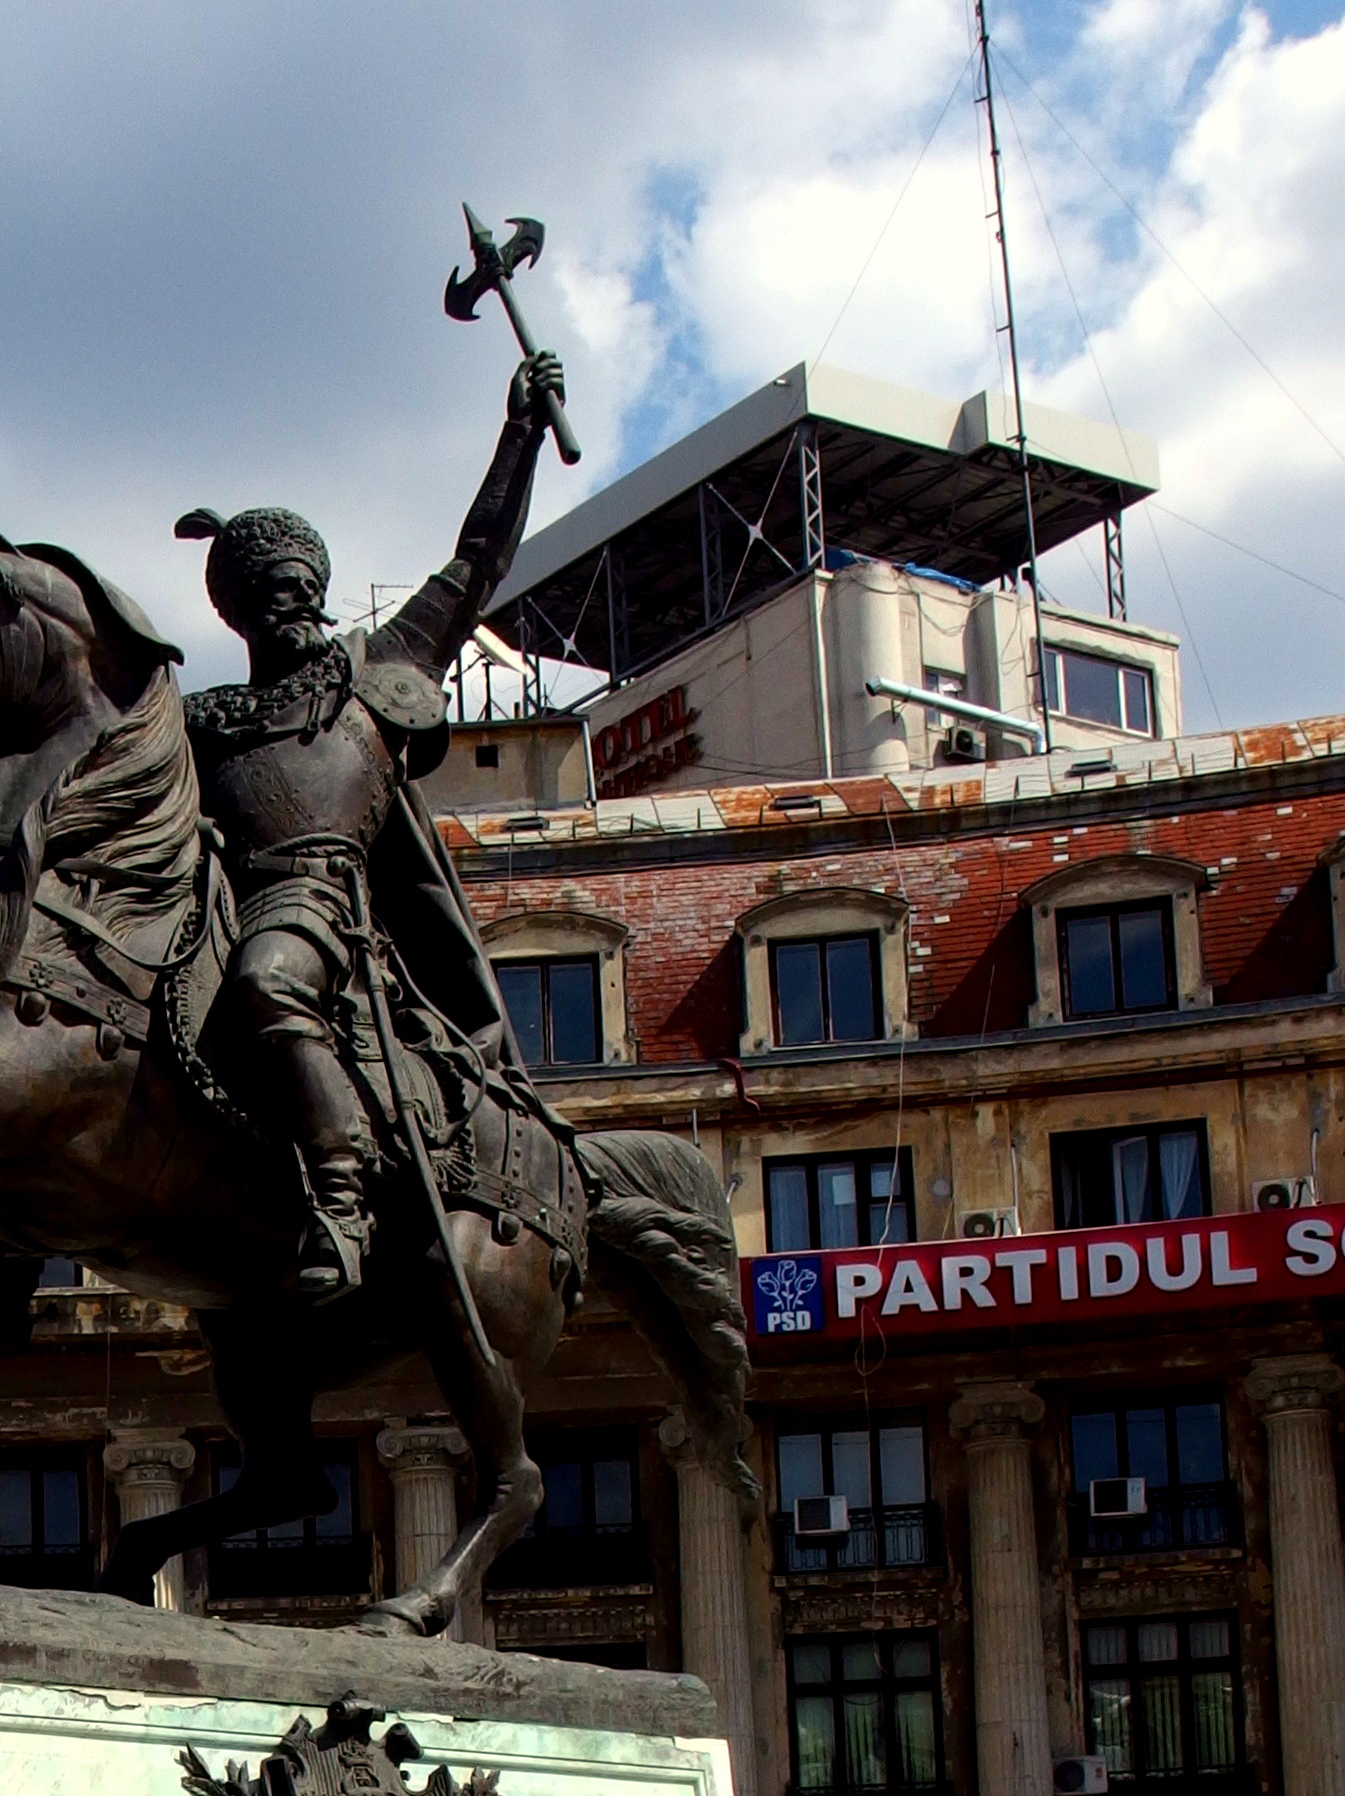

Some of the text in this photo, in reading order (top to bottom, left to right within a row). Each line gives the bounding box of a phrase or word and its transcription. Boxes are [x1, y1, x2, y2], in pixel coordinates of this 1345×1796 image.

[591, 686, 700, 770] OTEL
[836, 1219, 1345, 1318] PARTIDUL S
[766, 1310, 812, 1333] PSD
